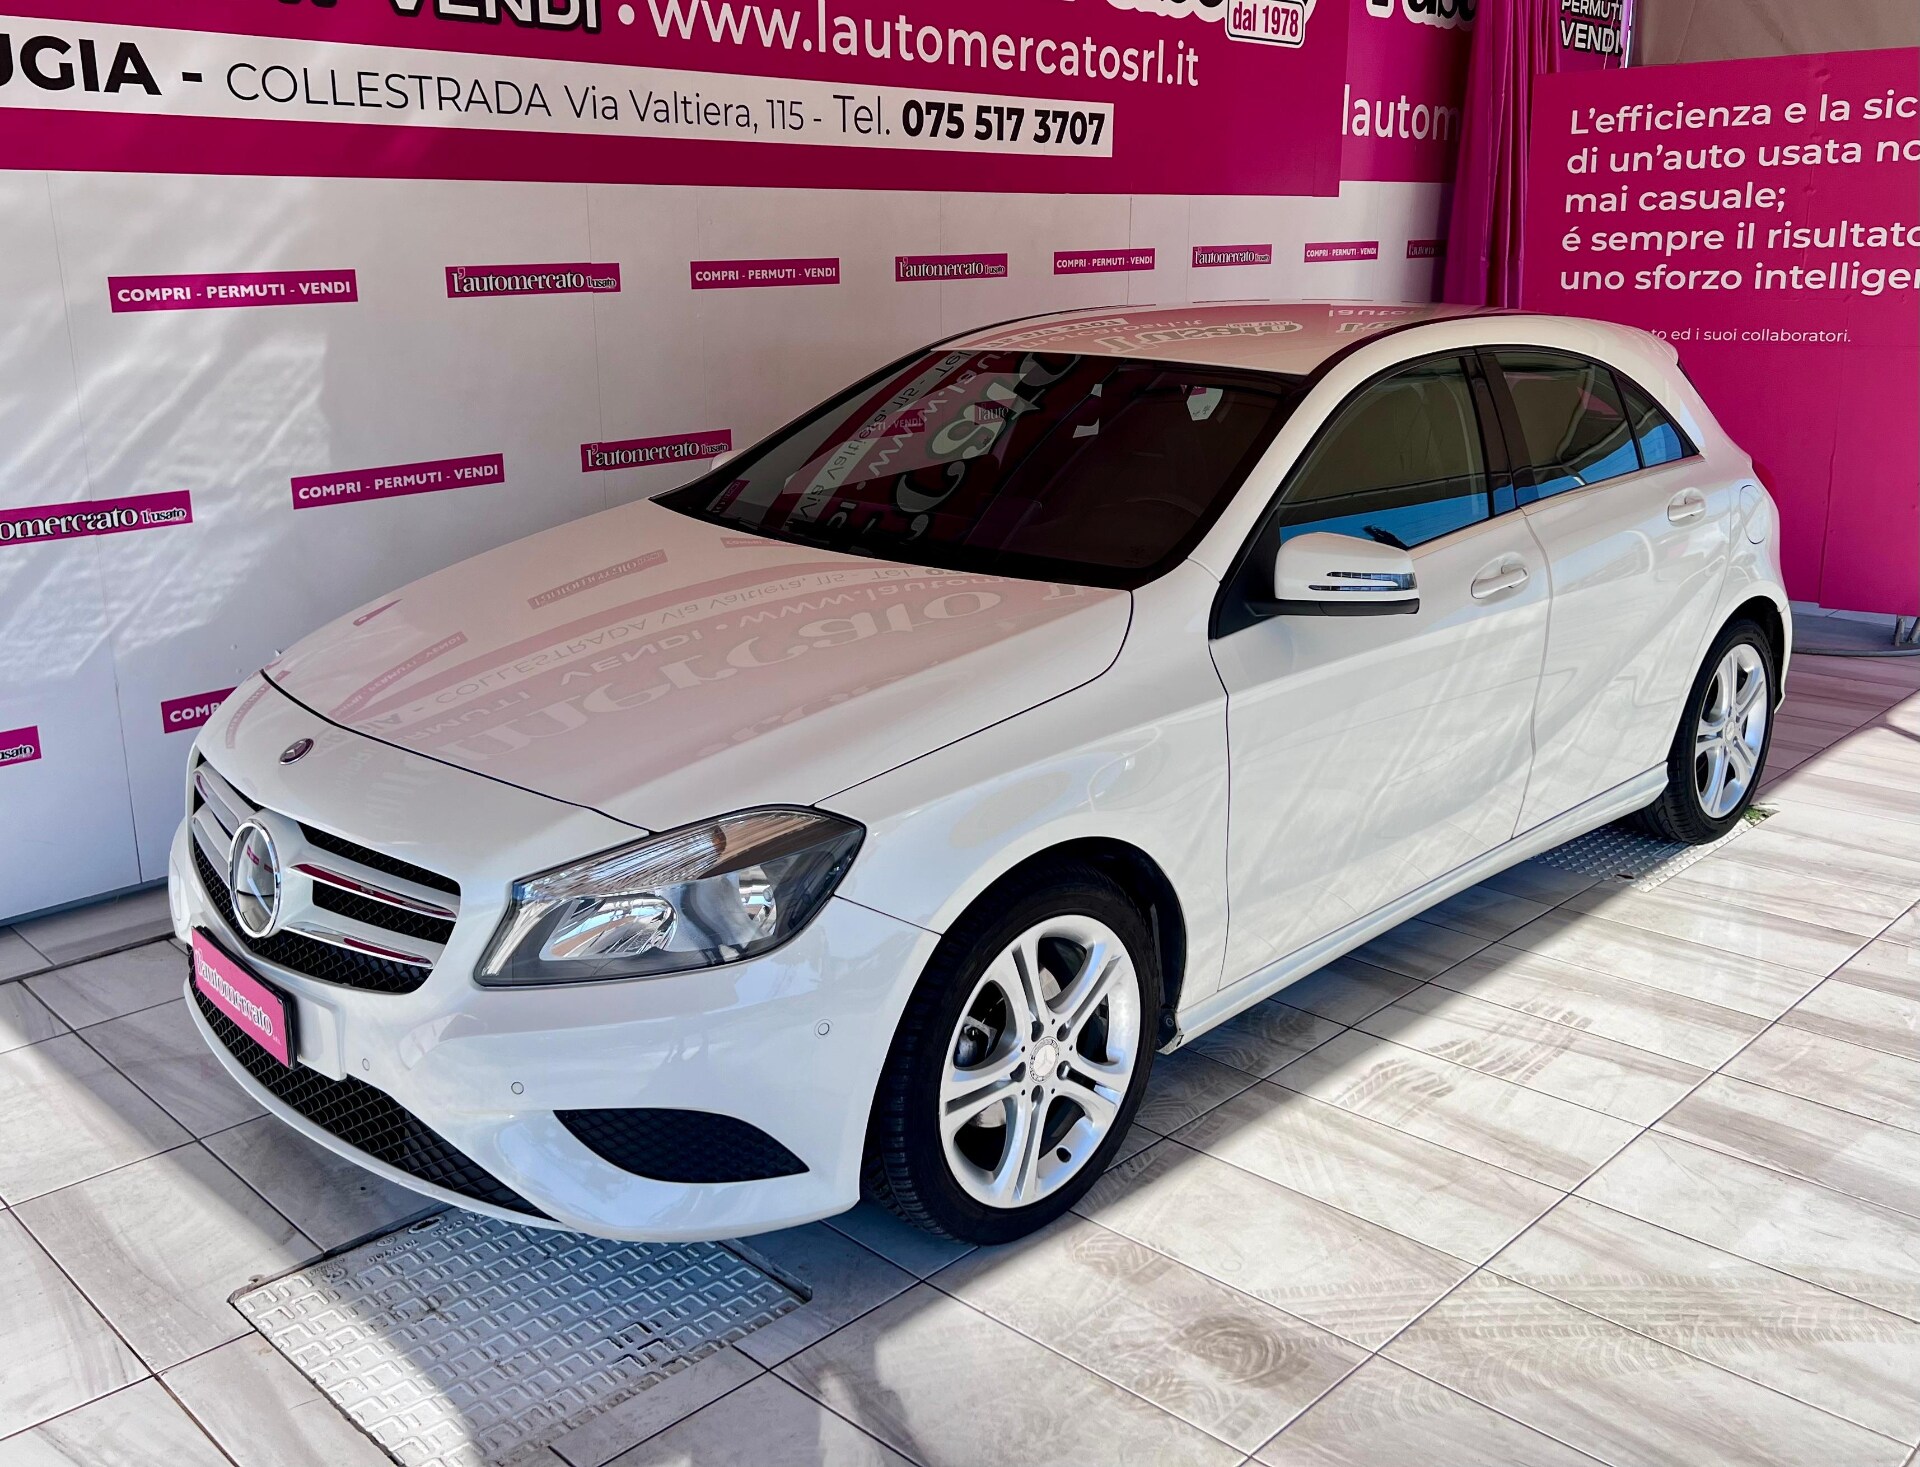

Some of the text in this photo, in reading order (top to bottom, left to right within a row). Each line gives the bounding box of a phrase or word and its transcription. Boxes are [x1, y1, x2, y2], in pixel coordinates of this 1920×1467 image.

[1233, 2, 1256, 32] dal
[1262, 4, 1299, 38] 1978
[1560, 19, 1621, 54] VENDI
[649, 0, 1200, 87] www.lautomercatosrl.it
[226, 62, 553, 118] COLLESTRADA
[564, 84, 620, 121] Via
[628, 90, 759, 135] Valtiera,
[766, 98, 805, 132] 115
[833, 93, 891, 137] Tel.
[901, 98, 965, 141] 075
[974, 105, 1027, 143] 517
[1033, 109, 1107, 147] 3707
[1784, 101, 1807, 124] e
[1819, 93, 1851, 122] la
[1862, 89, 1919, 120] sic
[1566, 146, 1599, 174] di
[1758, 139, 1862, 167] usata
[1876, 138, 1920, 162] no
[1565, 181, 1787, 213] mai casuale;
[1306, 249, 1329, 257] COMPRI
[1332, 248, 1357, 257] PERMUTI
[1561, 220, 1920, 257] é sempre il risultato
[695, 270, 739, 282] COMPRI
[748, 268, 796, 280] PERMUTI
[804, 267, 836, 278] VENDI
[1056, 258, 1087, 269] COMPRI
[1092, 257, 1125, 267] PERMUTI
[1130, 255, 1153, 265] VENDI
[1560, 270, 1625, 290] uno
[1634, 263, 1743, 290] sforzo
[117, 286, 192, 303] COMPRI
[206, 283, 286, 299] PERMUTI
[299, 281, 351, 295] VENDI
[1671, 328, 1691, 341] ed
[1695, 327, 1700, 341] i
[1703, 327, 1737, 341] suoi
[1741, 328, 1851, 343] collaboratori.
[298, 481, 361, 500] COMPRI
[374, 471, 442, 491] PERMUTI
[453, 464, 498, 480] VENDI
